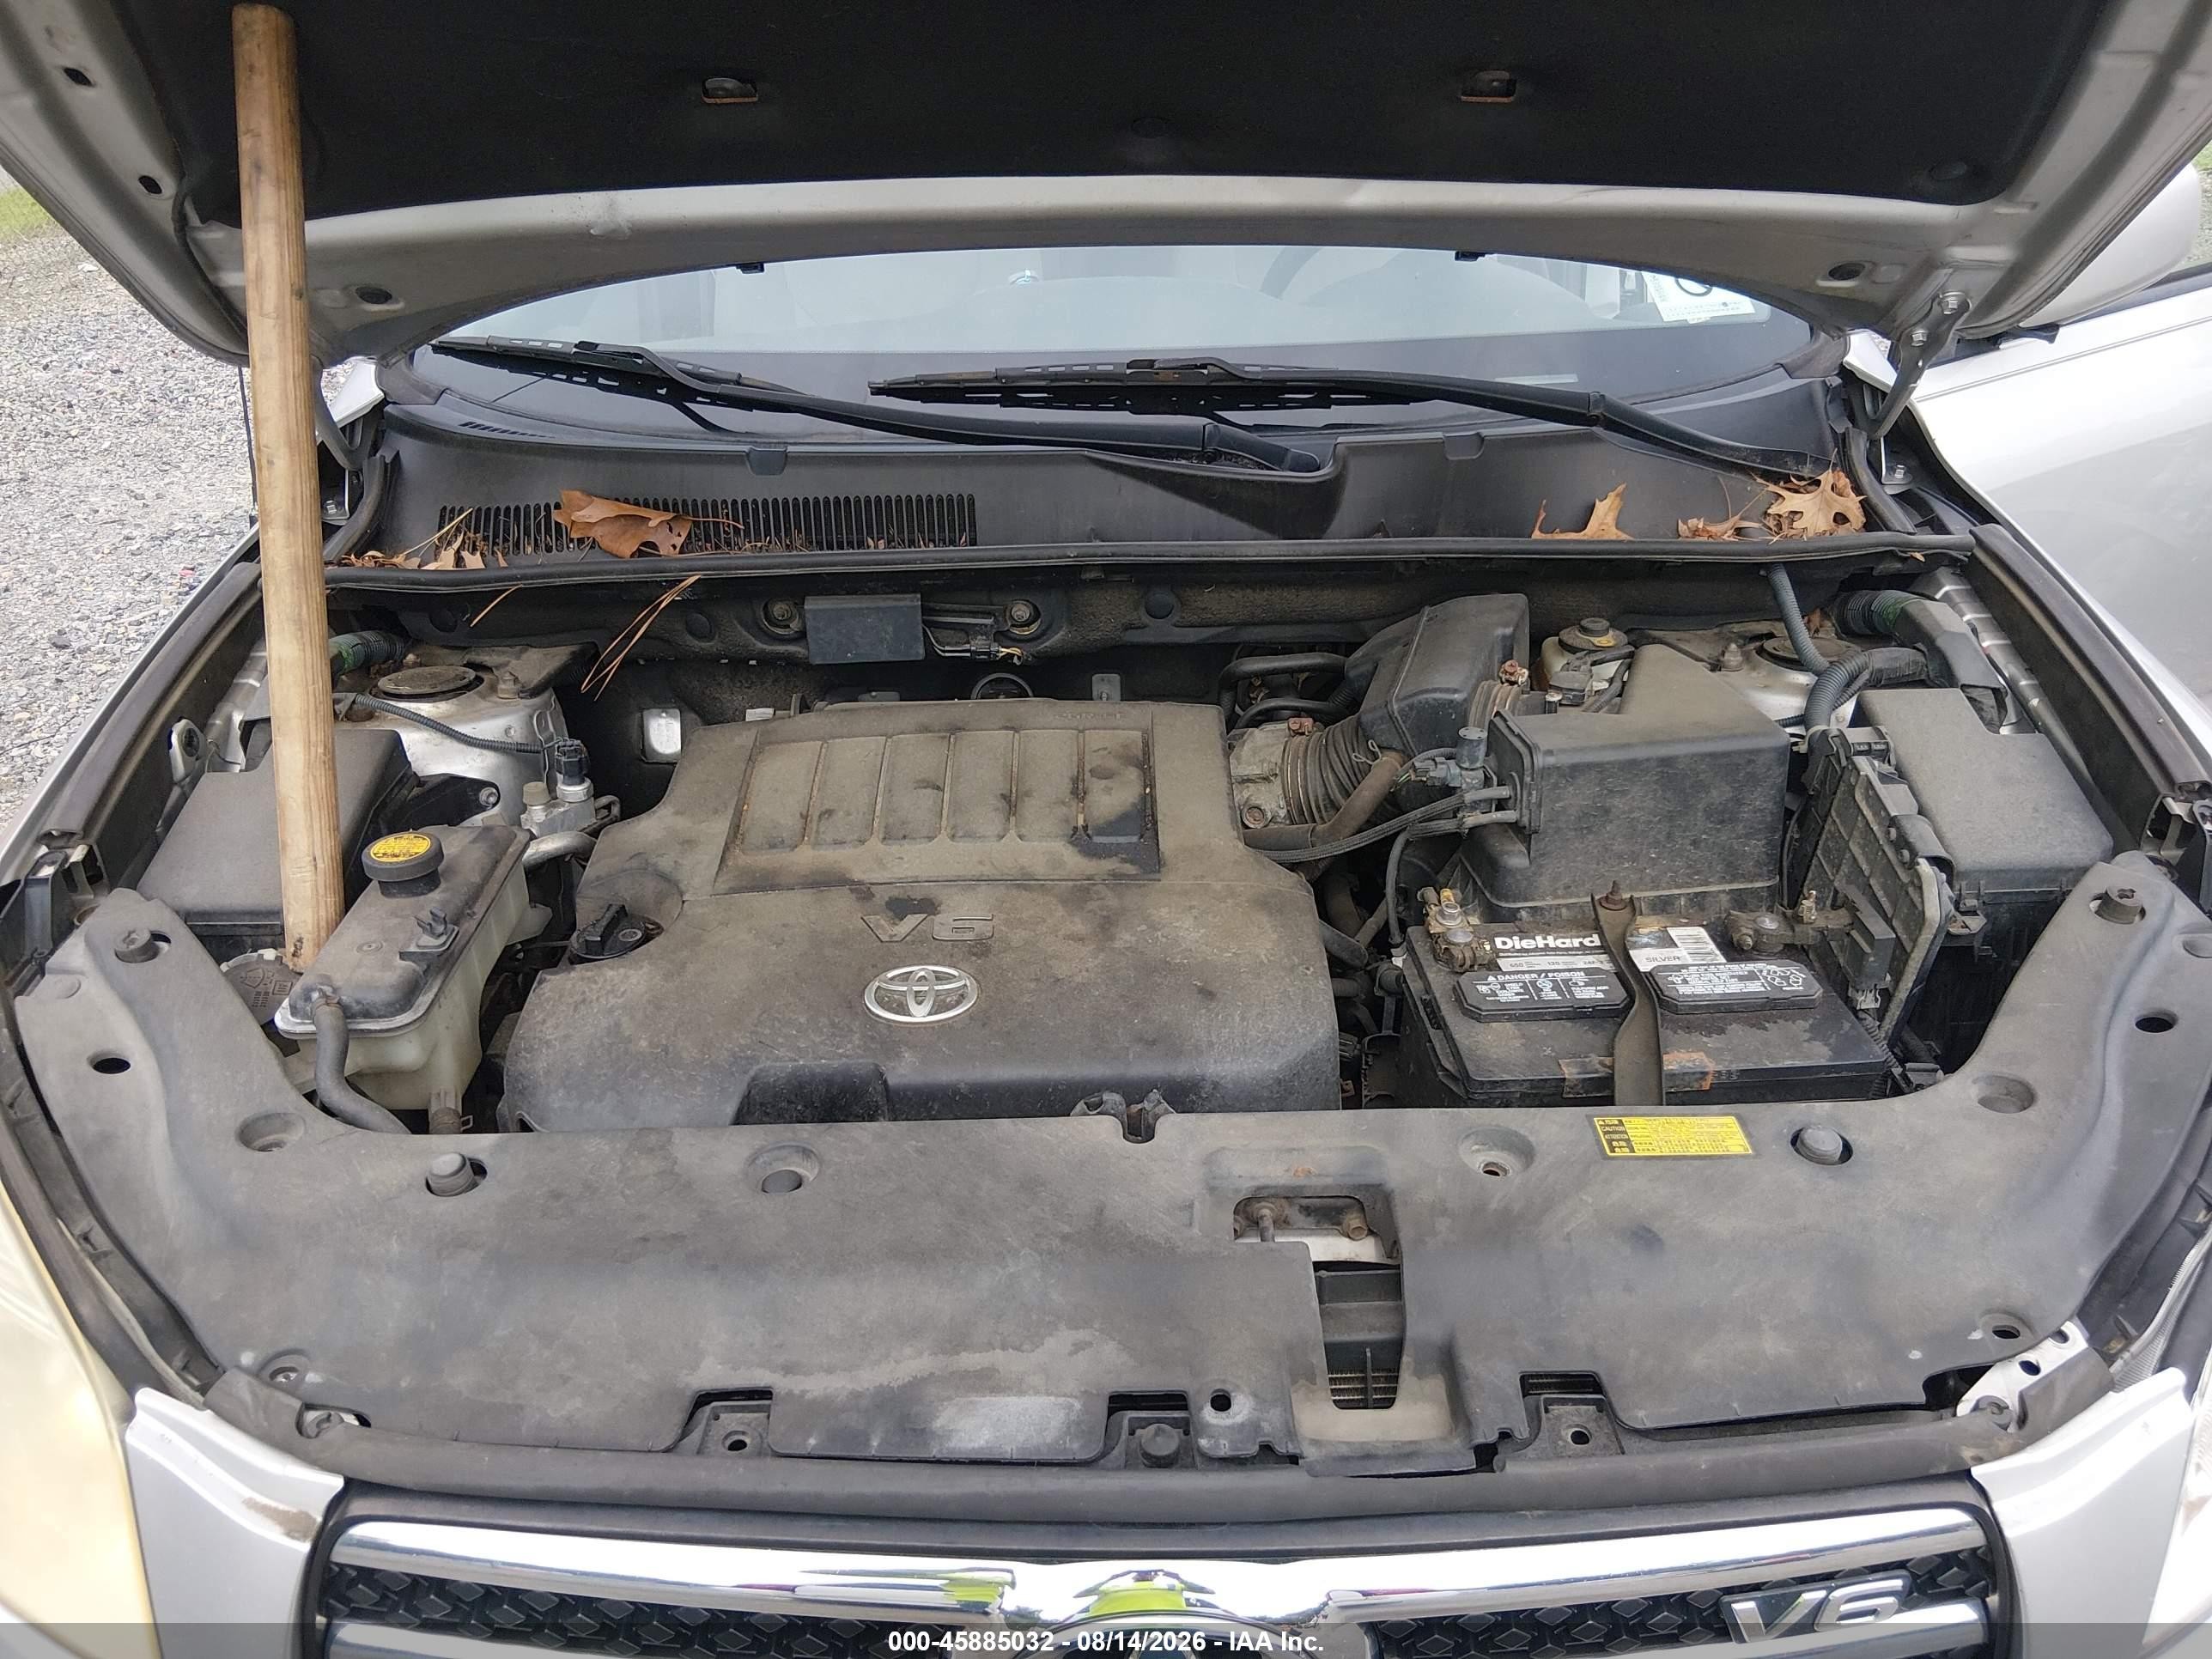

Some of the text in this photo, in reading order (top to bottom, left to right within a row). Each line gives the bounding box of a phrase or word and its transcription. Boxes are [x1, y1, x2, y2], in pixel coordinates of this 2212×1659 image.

[860, 913, 994, 942] V6
[1494, 933, 1601, 950] DieHard
[1730, 1578, 1904, 1644] V6
